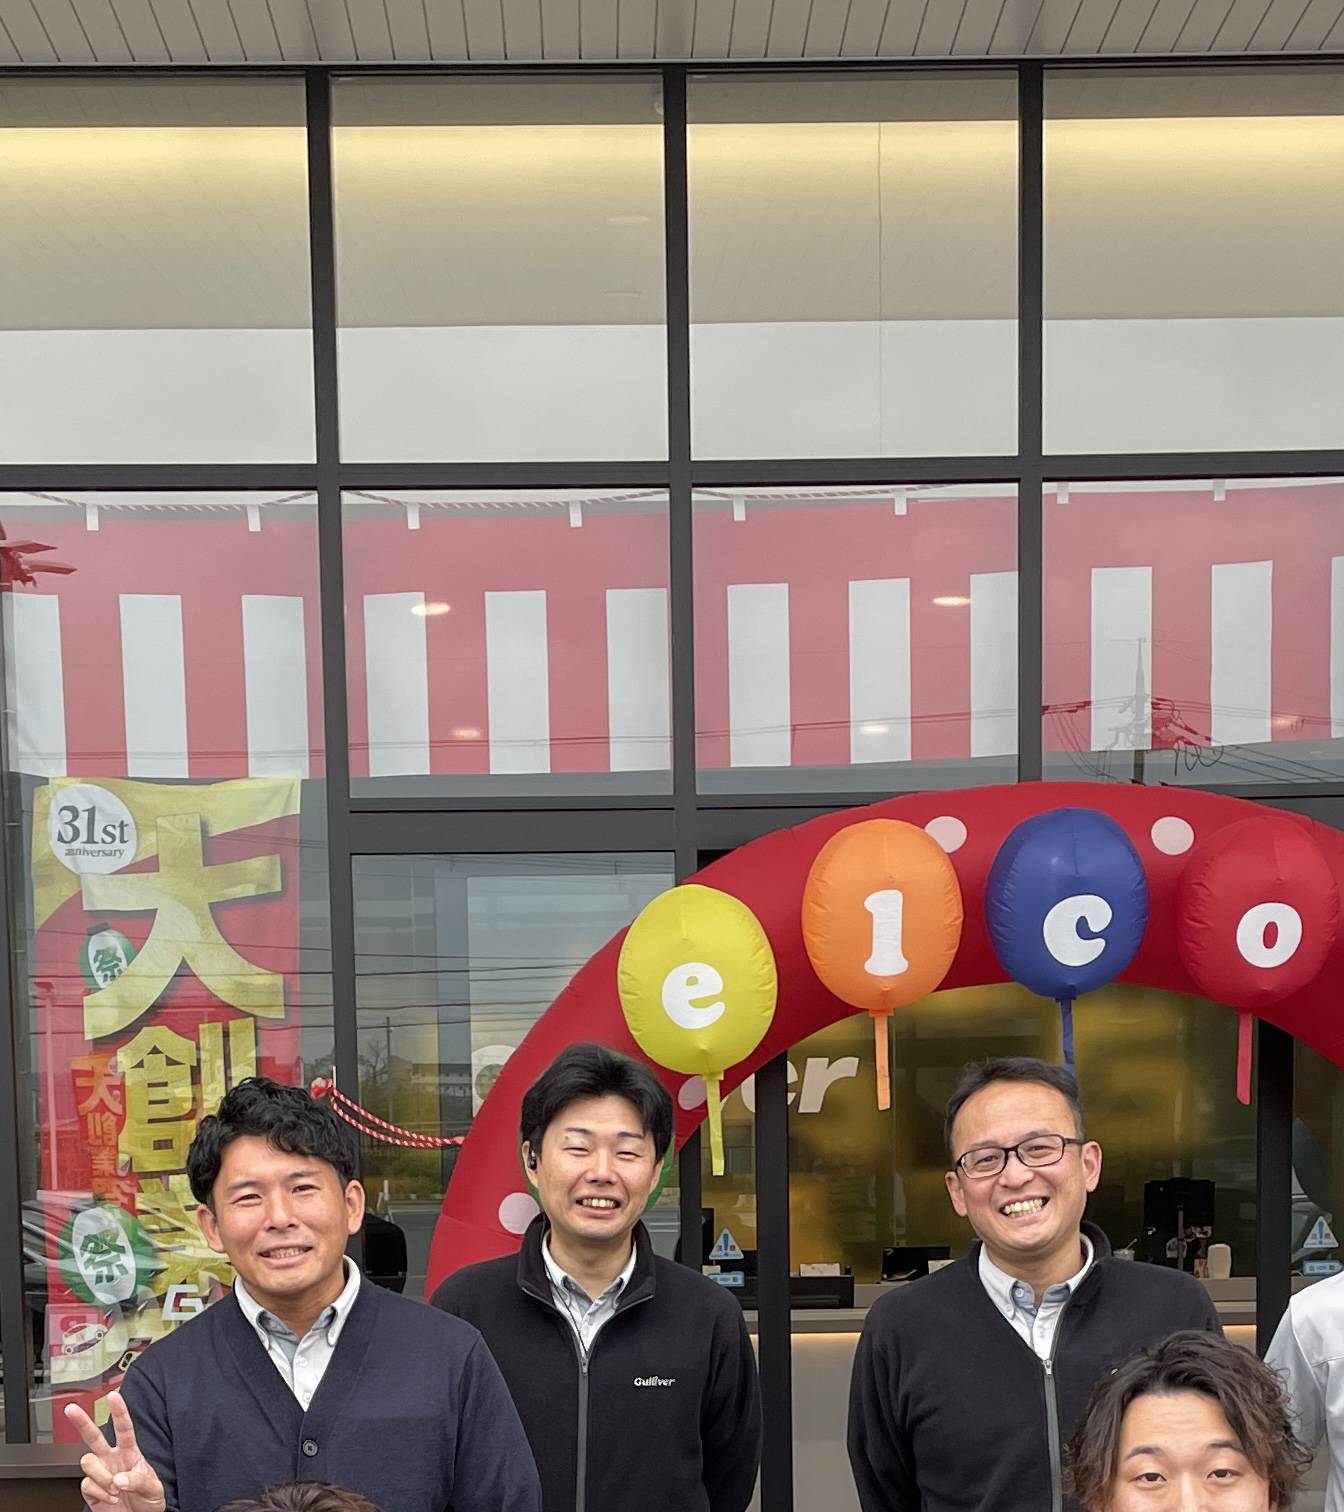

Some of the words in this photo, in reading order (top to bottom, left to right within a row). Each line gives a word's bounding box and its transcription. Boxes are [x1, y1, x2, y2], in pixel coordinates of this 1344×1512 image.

[56, 805, 129, 847] 31st
[80, 1228, 128, 1286] 祭
[633, 1374, 677, 1389] Gulliver
